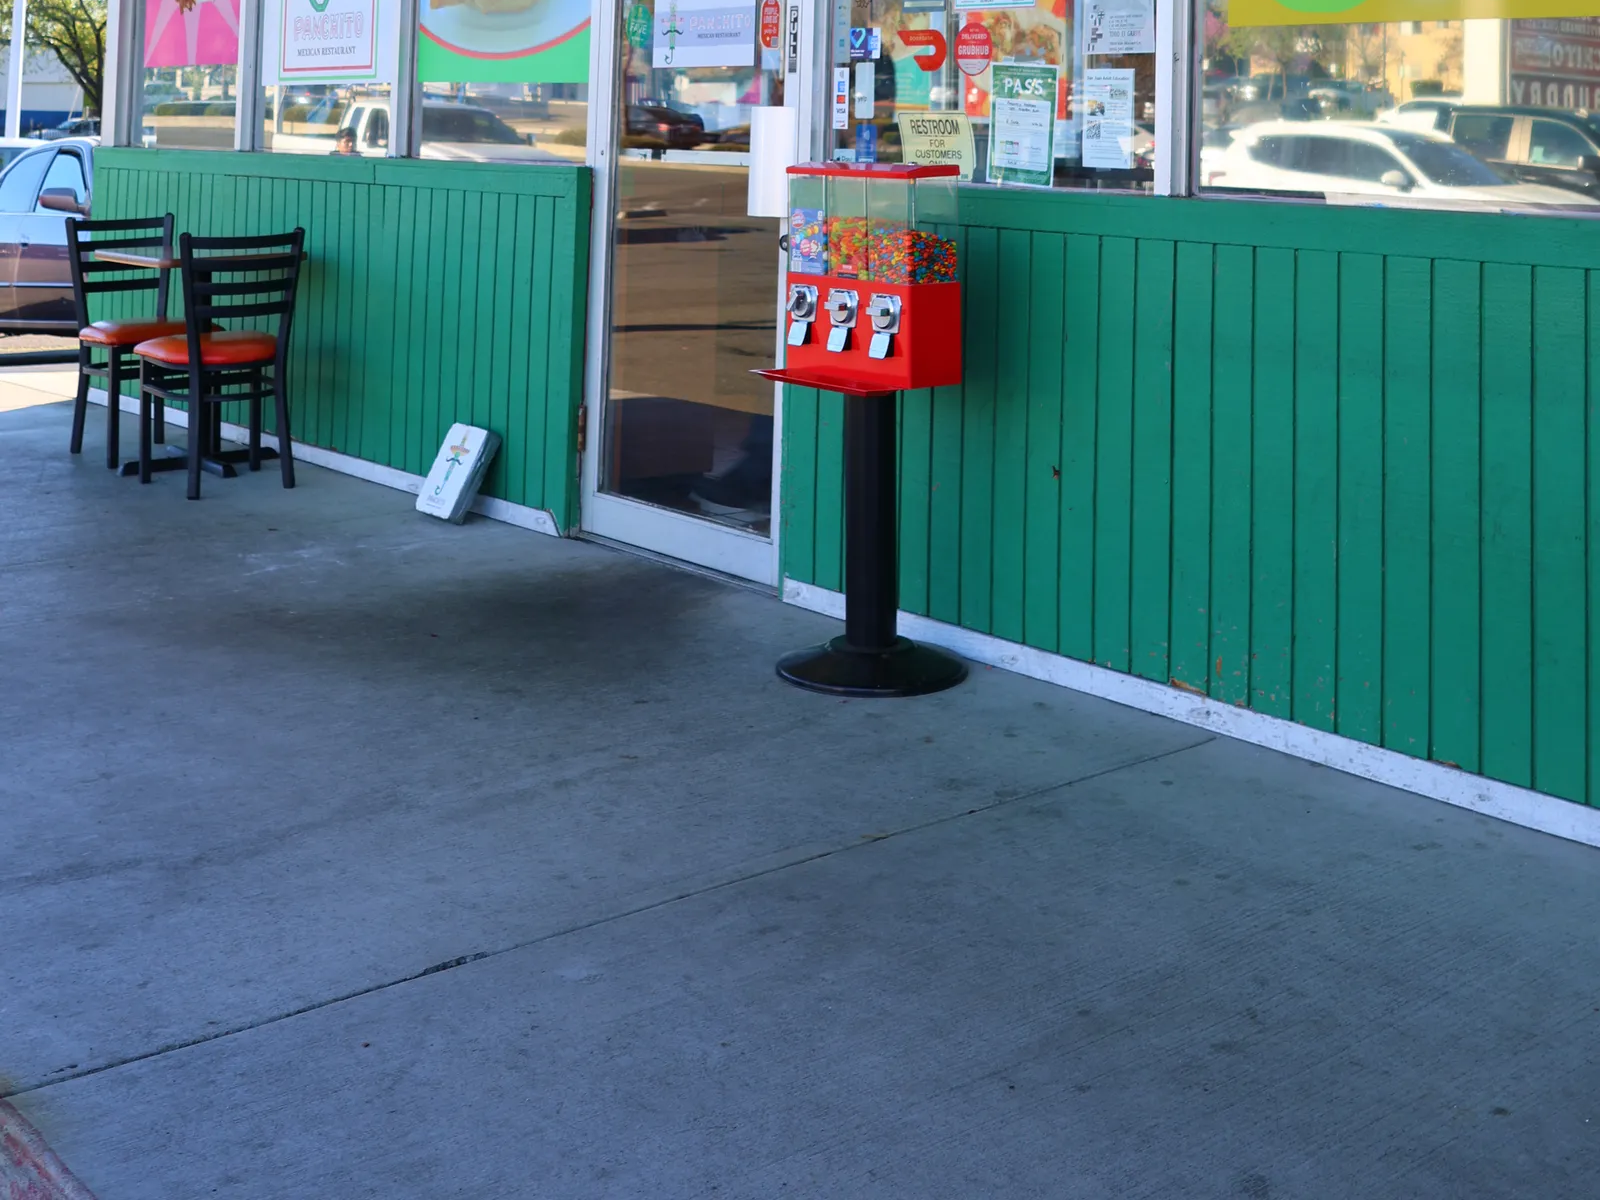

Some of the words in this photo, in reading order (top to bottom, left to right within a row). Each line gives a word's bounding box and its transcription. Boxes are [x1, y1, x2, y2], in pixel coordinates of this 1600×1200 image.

[293, 11, 365, 42] PANCHITO
[629, 21, 648, 35] FAVE
[689, 13, 752, 31] PANCHITO
[789, 10, 798, 58] PULL
[297, 47, 321, 56] MEXICAN
[321, 46, 356, 56] RESTAURANT
[958, 45, 989, 55] GRUBHUB
[1004, 77, 1044, 96] PASS
[910, 119, 961, 135] RESTROOM
[929, 139, 946, 148] FOR
[915, 149, 962, 160] CUSTOMERS
